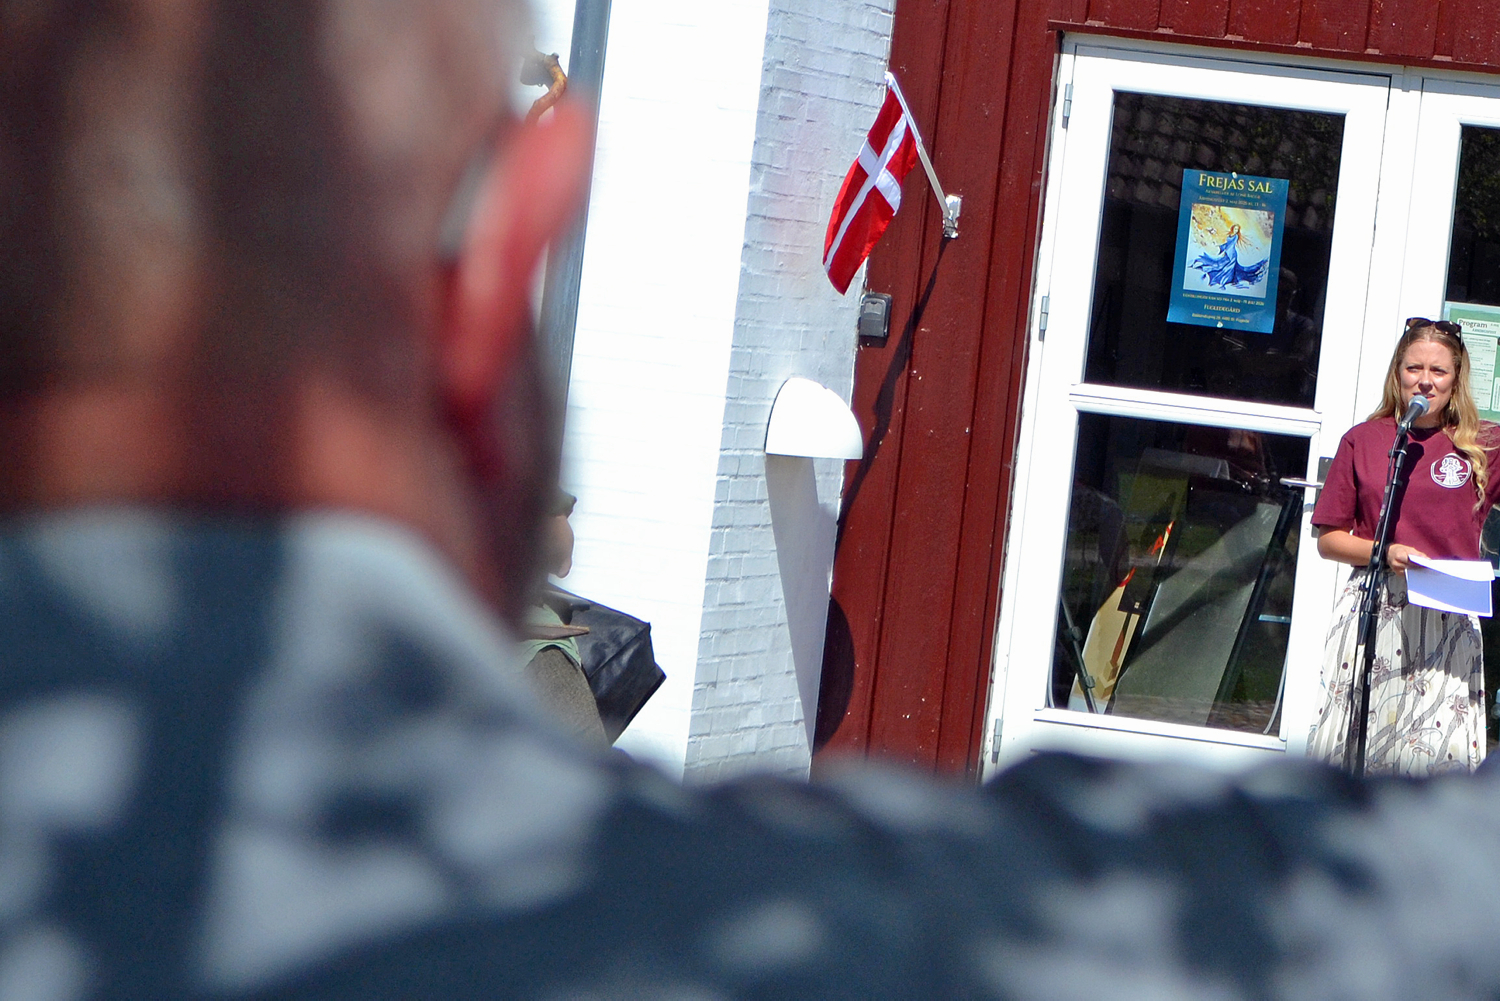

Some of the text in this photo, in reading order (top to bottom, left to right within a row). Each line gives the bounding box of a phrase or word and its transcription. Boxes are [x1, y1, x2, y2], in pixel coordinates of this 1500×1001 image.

[1199, 173, 1273, 193] FREJAS SAL
[1459, 320, 1487, 328] Program
